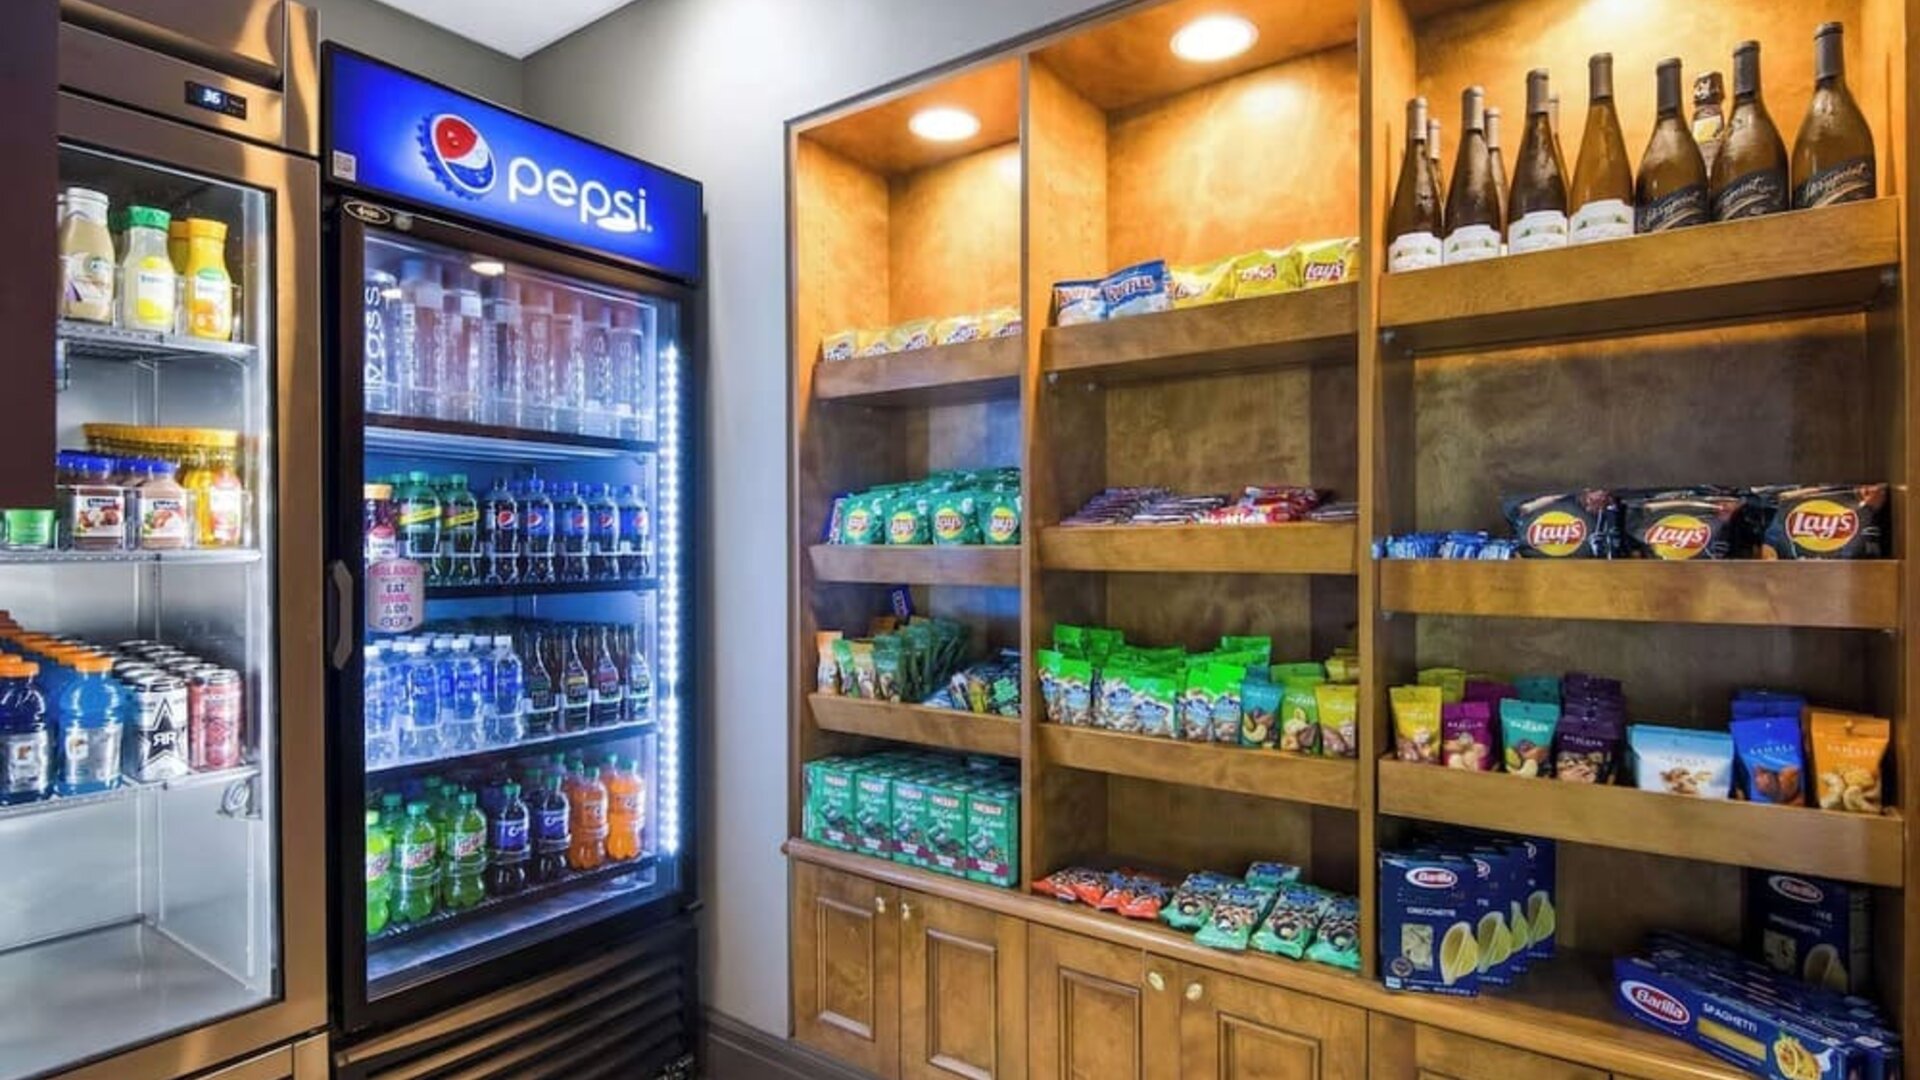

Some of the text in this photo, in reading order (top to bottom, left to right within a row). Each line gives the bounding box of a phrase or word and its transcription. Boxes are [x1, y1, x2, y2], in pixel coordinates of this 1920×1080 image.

[508, 156, 647, 231] pepsi
[1636, 988, 1684, 1020] Barilla
[1702, 1002, 1758, 1034] SPAGHETTI
